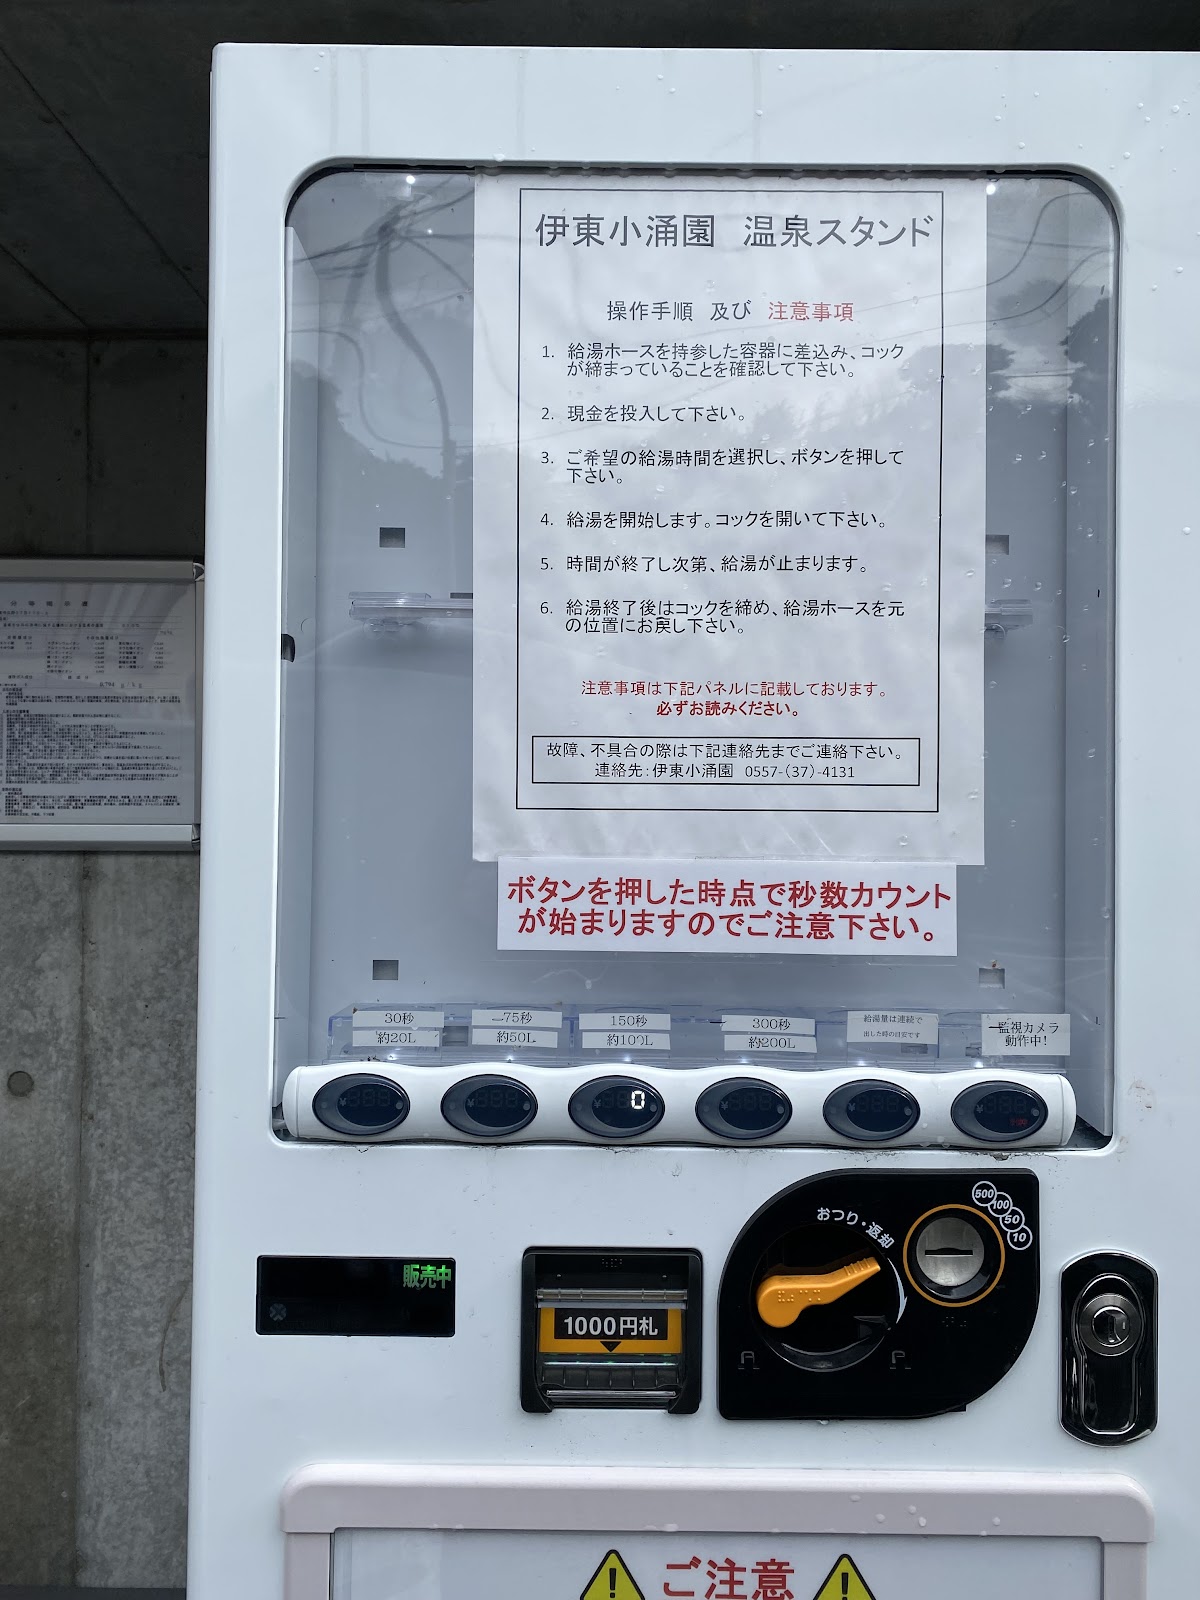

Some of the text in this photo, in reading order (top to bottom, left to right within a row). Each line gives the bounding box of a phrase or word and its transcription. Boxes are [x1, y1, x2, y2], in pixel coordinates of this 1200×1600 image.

[535, 213, 934, 248] 伊東小涌園 温泉スタンド
[606, 300, 854, 322] 操作手順 及び 注意事項
[542, 342, 905, 361] 1. 給湯ホースを持参した容器に差込み、コック
[566, 359, 856, 379] が締まっていることを確認して下さい。
[541, 404, 749, 423] 2. 現金を投入して下さい。
[541, 447, 904, 467] 3. ご希望の給湯時間を選択し、ボタンを押して
[566, 468, 625, 485] 下さい。
[540, 510, 887, 530] 4. 給湯を開始します。コックを開いて下さい。
[540, 554, 868, 574] 5. 時間が終了し次第、給湯が止まります。
[540, 599, 905, 618] 6. 給湯終了後はコックを締め、給湯ホースを元
[565, 617, 747, 635] の位置にお戻し下さい。
[580, 679, 887, 698] 注意事項は下記パネルに記載しております。
[655, 699, 800, 717] 必ずお読みください。
[546, 742, 903, 761] 故障、不具合の際は下記連絡先までご連絡下さい。
[506, 877, 953, 909] ボタンを押した時点で秒数カウント
[517, 908, 936, 943] が始まりますのでご注意下さい。
[384, 1012, 414, 1024] 30秒
[502, 1012, 532, 1024] 75秒
[610, 1015, 648, 1027] 150秒
[752, 1018, 791, 1031] 300秒
[863, 1014, 923, 1024] 給湯量は連続で
[998, 1021, 1060, 1034] 監視カメラ
[377, 1031, 417, 1044] 約20L
[496, 1030, 536, 1043] 約50L
[748, 1036, 796, 1049] 約200L
[863, 1030, 920, 1039] 出した時の目安です
[630, 1090, 645, 1110] 0
[974, 1189, 994, 1198] 500
[992, 1200, 1009, 1209] 100
[816, 1207, 895, 1249] おつり・返却
[1004, 1215, 1019, 1224] 50
[1012, 1232, 1027, 1242] 10
[403, 1264, 452, 1289] 販売中
[564, 1316, 659, 1336] 1000円札
[663, 1556, 795, 1600] ご注意
